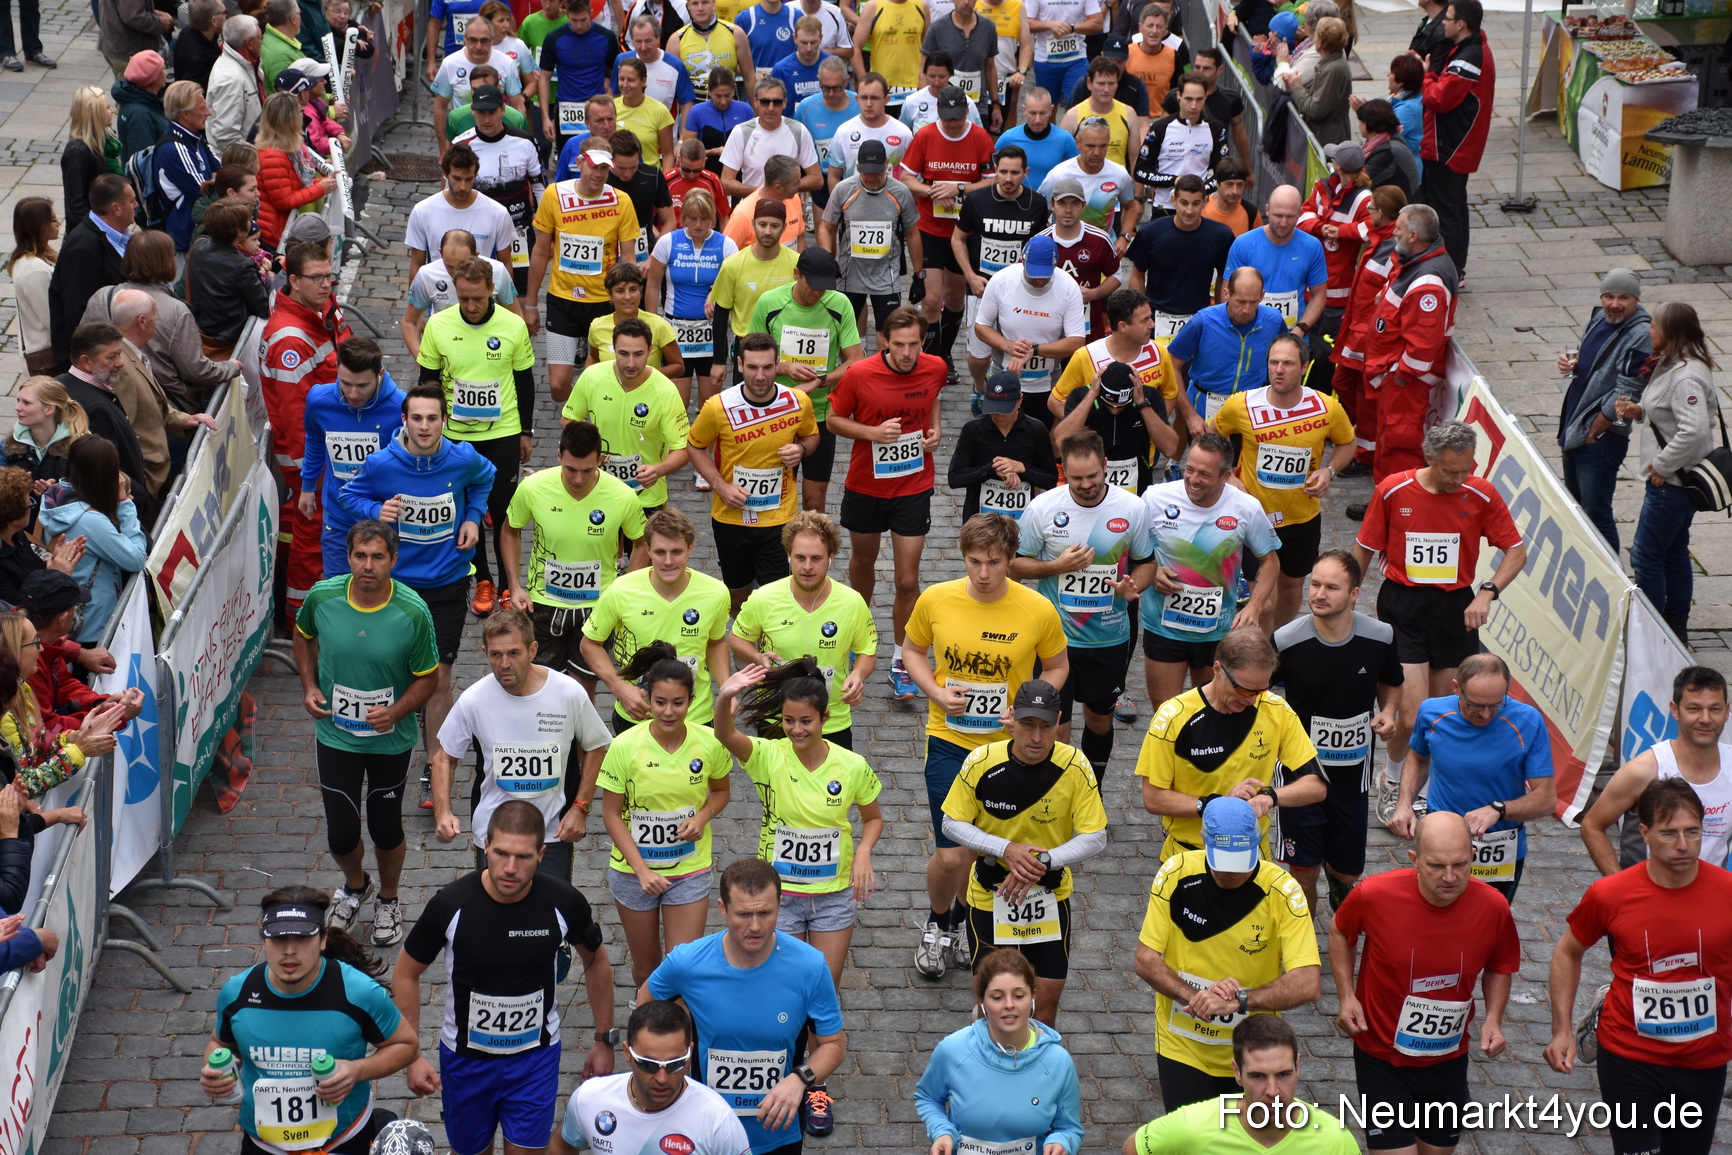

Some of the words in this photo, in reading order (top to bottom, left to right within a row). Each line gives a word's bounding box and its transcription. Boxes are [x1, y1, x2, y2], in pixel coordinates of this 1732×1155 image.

[1050, 39, 1077, 53] 2508
[794, 81, 821, 94] HUBE
[562, 108, 584, 123] 308
[1638, 144, 1673, 168] Neumark
[928, 160, 970, 171] NEUMARKT
[1622, 152, 1672, 179] Lammsb
[562, 213, 588, 224] MAX
[590, 208, 620, 220] BÖGL
[983, 217, 1032, 235] THULE
[575, 237, 598, 245] Neumarkt
[858, 230, 884, 245] 278
[563, 242, 599, 260] 2731
[984, 247, 1018, 264] 2219
[569, 262, 590, 271] Jürgen
[673, 259, 720, 270] Neumüller
[677, 327, 713, 344] 2820
[799, 331, 823, 339] Neumarkt
[797, 339, 816, 355] 18
[486, 351, 502, 359] Partl
[457, 389, 497, 406] 3066
[629, 416, 647, 426] Partl
[734, 427, 767, 445] MAX
[770, 415, 803, 434] BÖGL
[1255, 428, 1289, 444] MAX
[1292, 418, 1330, 434] BÖGL
[878, 442, 920, 463] 2385
[1278, 448, 1304, 456] Neumarkt
[889, 462, 912, 472] Fabian
[1262, 453, 1306, 473] 2760
[734, 469, 750, 477] PARTL
[751, 471, 777, 479] Neumarkt
[1266, 474, 1296, 484] Matthias
[738, 477, 779, 496] 2767
[400, 498, 418, 506] PARTL
[418, 499, 447, 507] Neumarkt
[984, 489, 1026, 509] 2480
[404, 506, 451, 524] 2409
[419, 526, 436, 535] Max
[587, 525, 605, 534] Partl
[1412, 545, 1448, 564] 515
[1082, 568, 1109, 576] Neumarkt
[550, 570, 597, 589] 2204
[557, 590, 588, 600] Dominik
[1186, 588, 1214, 597] Neumarkt
[1073, 597, 1099, 608] Timmy
[1170, 592, 1216, 616] 2225
[1175, 614, 1206, 628] Andreas
[681, 626, 700, 636] Partl
[981, 631, 1007, 641] swn
[819, 638, 837, 648] Partl
[1486, 598, 1585, 736] TERSTEINE
[335, 687, 353, 699] PARTL
[354, 693, 384, 701] Neumarkt
[962, 692, 1001, 715] 732
[956, 715, 993, 727] Christian
[1312, 719, 1334, 728] PARTL
[1335, 719, 1363, 729] Neumarkt
[1316, 726, 1367, 749] 2025
[1190, 745, 1224, 757] Markus
[1324, 750, 1358, 760] Andreas
[500, 755, 553, 777] 2301
[514, 780, 543, 791] Rudolf
[826, 796, 843, 806] Partl
[985, 798, 1017, 812] Steffen
[632, 813, 654, 822] PARTL
[655, 813, 687, 822] Neumarkt
[638, 823, 685, 845] 203
[776, 828, 799, 839] PARTL
[799, 831, 831, 841] Neumarkt
[647, 847, 684, 859] Vanessa
[780, 839, 833, 864] 2031
[789, 864, 821, 877] Nadine
[1470, 865, 1499, 877] swald
[1006, 898, 1046, 924] 345
[1183, 906, 1208, 926] Peter
[514, 928, 550, 938] PFLEIDERER
[1011, 924, 1042, 938] Steffen
[1664, 956, 1686, 968] DEHN
[1424, 977, 1447, 989] DEHN
[1634, 985, 1660, 994] PARTL
[1661, 986, 1702, 995] Neumarkt
[471, 998, 496, 1008] PARTL
[497, 999, 535, 1010] Neumarkt
[1405, 1000, 1431, 1012] PARTL
[1432, 1004, 1465, 1014] Neumarkt
[1642, 994, 1710, 1020] 2610
[475, 1007, 538, 1033] 2422
[1405, 1010, 1465, 1036] 2554
[1193, 1022, 1221, 1038] Peter
[1655, 1022, 1700, 1035] Berthold
[487, 1035, 523, 1048] Jochen
[1408, 1038, 1451, 1050] Johannes
[710, 1054, 736, 1064] PARTL
[737, 1056, 775, 1065] Neumarkt
[715, 1065, 780, 1091] 2258
[254, 1085, 281, 1094] PARTL
[282, 1084, 317, 1094] Neumar
[270, 1094, 318, 1124] 181
[283, 1128, 309, 1141] Sven
[592, 1137, 615, 1150] PARTL
[663, 1138, 693, 1152] Hervis
[959, 1142, 984, 1153] PARTL
